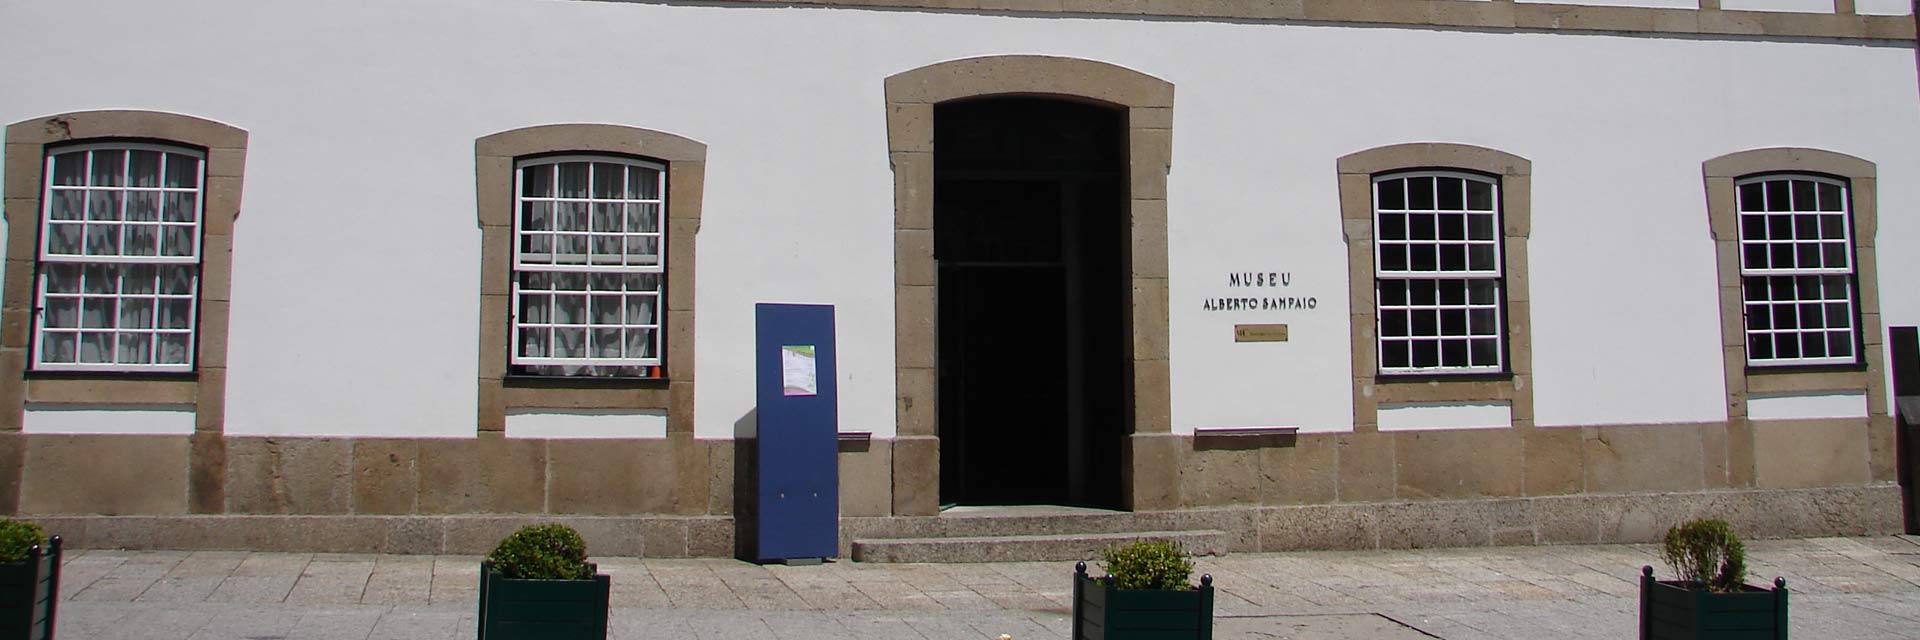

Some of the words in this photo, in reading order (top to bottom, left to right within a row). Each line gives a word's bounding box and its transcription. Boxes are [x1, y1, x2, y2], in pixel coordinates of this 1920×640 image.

[1229, 272, 1291, 287] MUSEU
[1203, 298, 1258, 311] ALBERTO
[1262, 297, 1317, 310] SAMPAIO
